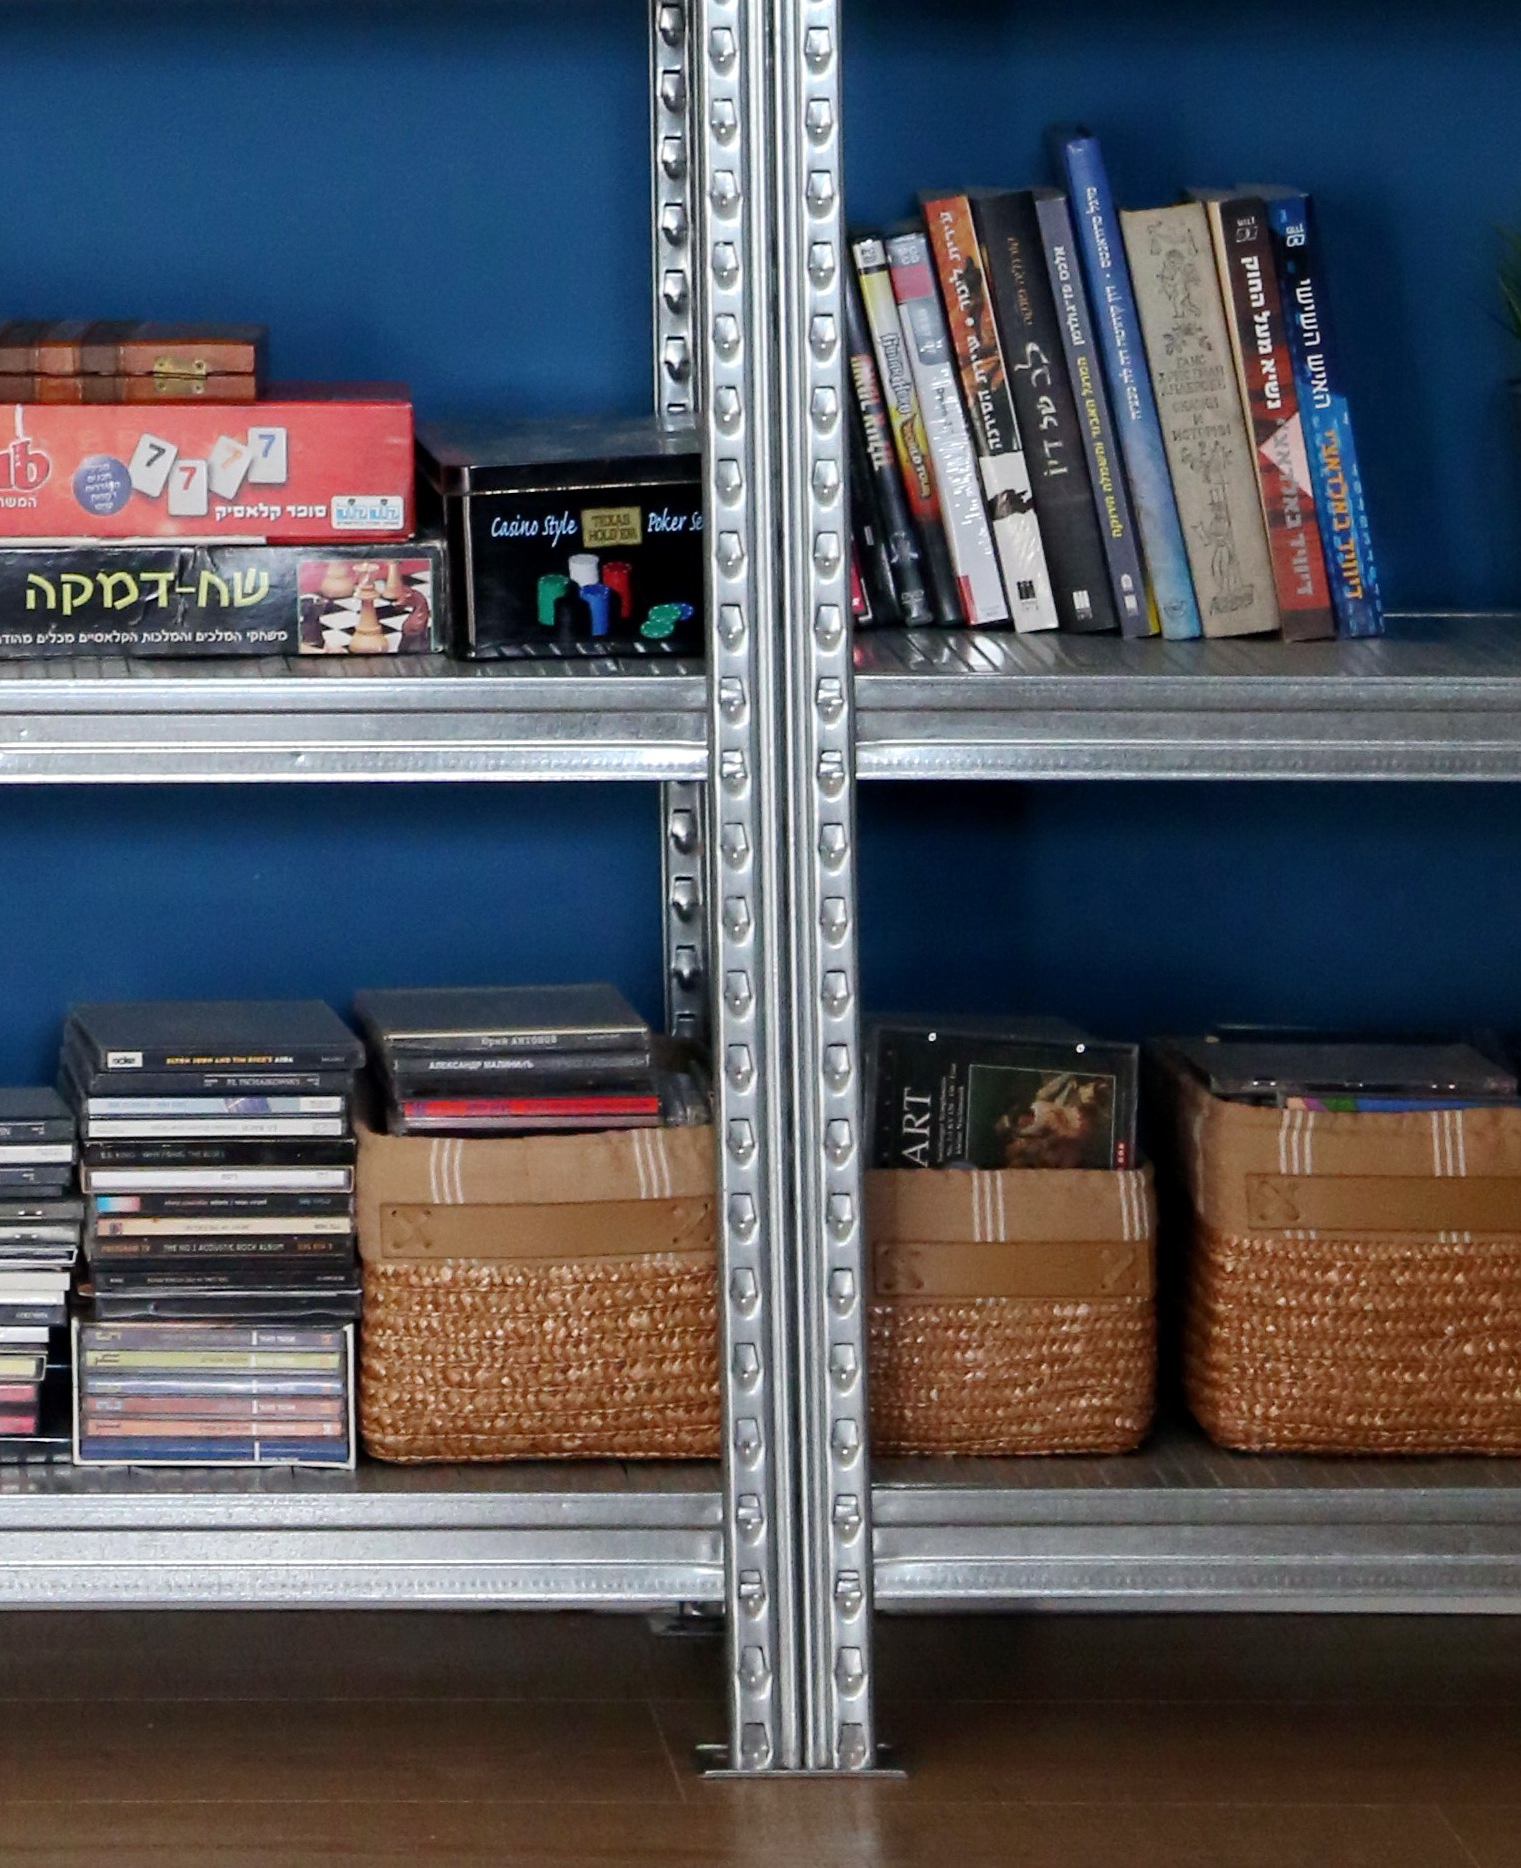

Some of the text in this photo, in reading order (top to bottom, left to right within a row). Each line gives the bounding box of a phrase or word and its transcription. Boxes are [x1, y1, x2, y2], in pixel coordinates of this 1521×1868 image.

[1295, 278, 1331, 409] האיש השישי
[146, 444, 165, 468] 7
[222, 446, 241, 469] 7
[259, 435, 276, 458] 7
[180, 466, 197, 491] 7
[215, 505, 327, 521] סופר קלאסיק
[491, 508, 686, 547] Casino Style Poker
[25, 568, 270, 616] שח-דמקה
[901, 1087, 931, 1167] ART
